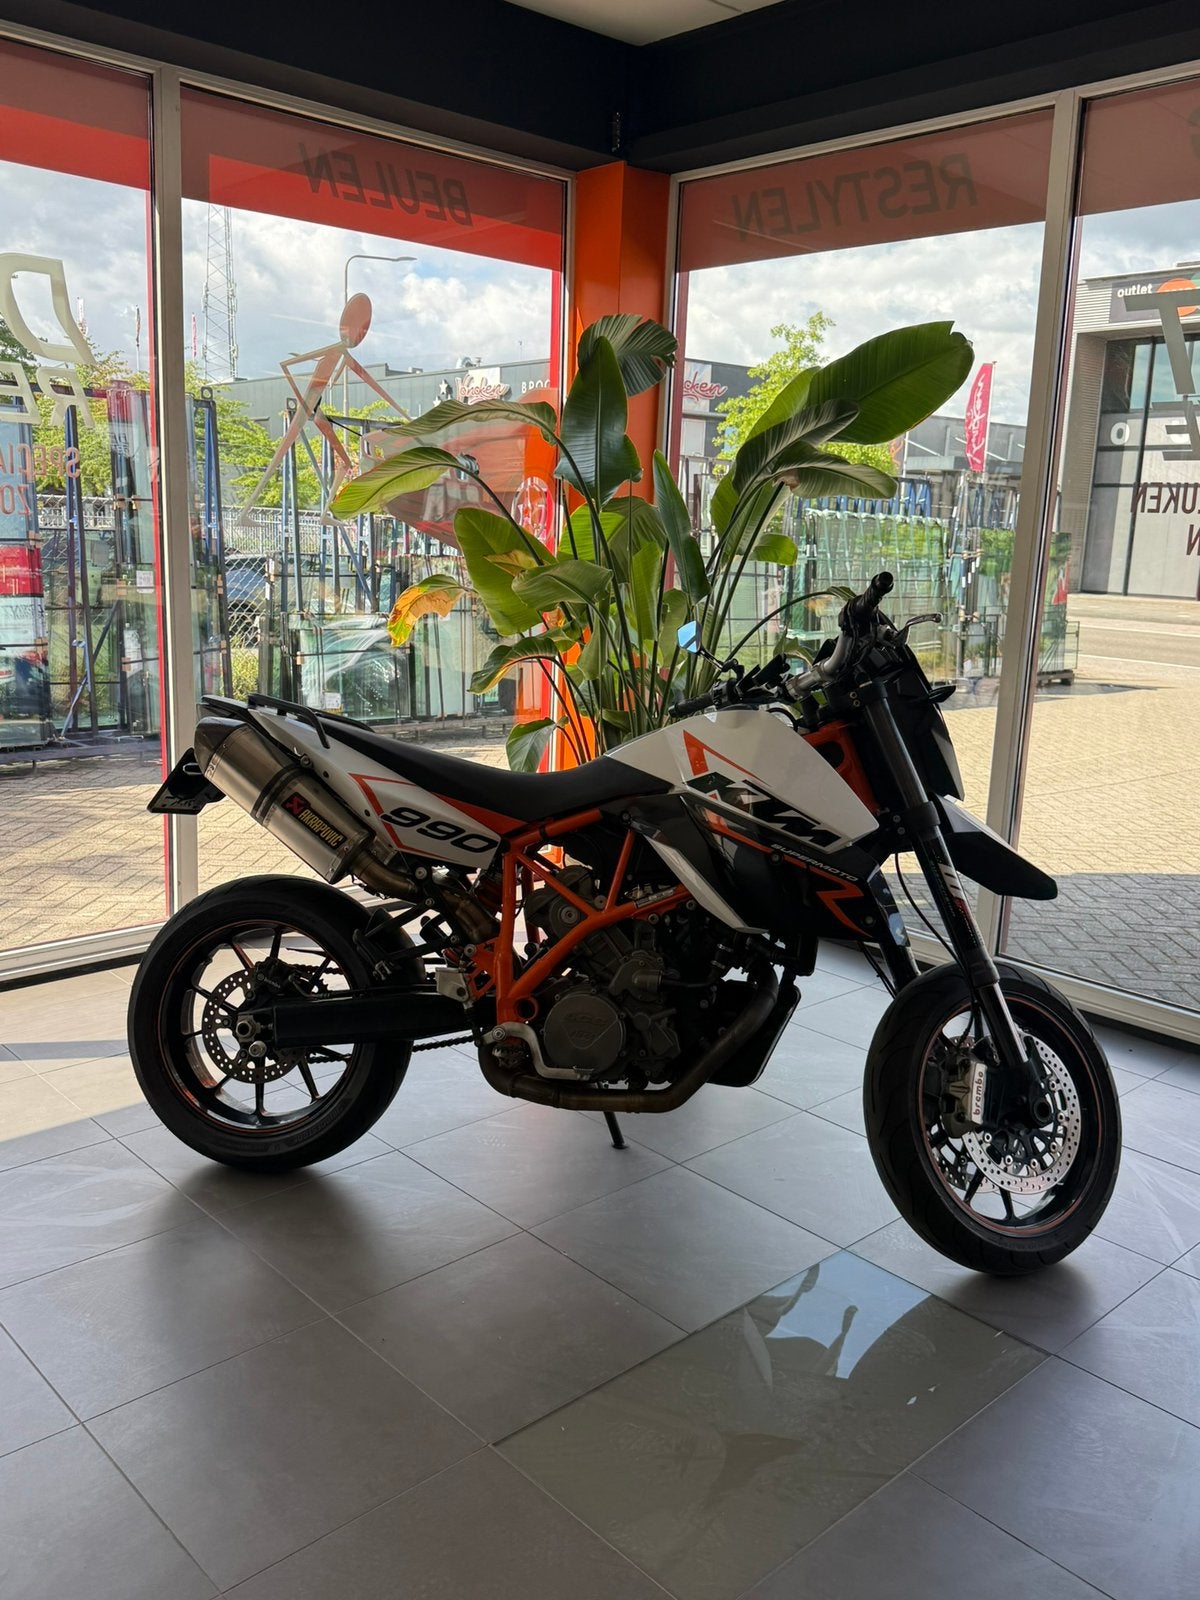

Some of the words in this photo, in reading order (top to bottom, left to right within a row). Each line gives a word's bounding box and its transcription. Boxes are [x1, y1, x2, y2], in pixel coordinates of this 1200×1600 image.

[1117, 283, 1153, 298] outlet
[380, 806, 499, 853] 990
[687, 771, 842, 848] KTM
[771, 843, 859, 882] SUPERMOTO
[972, 1071, 985, 1116] brembo
